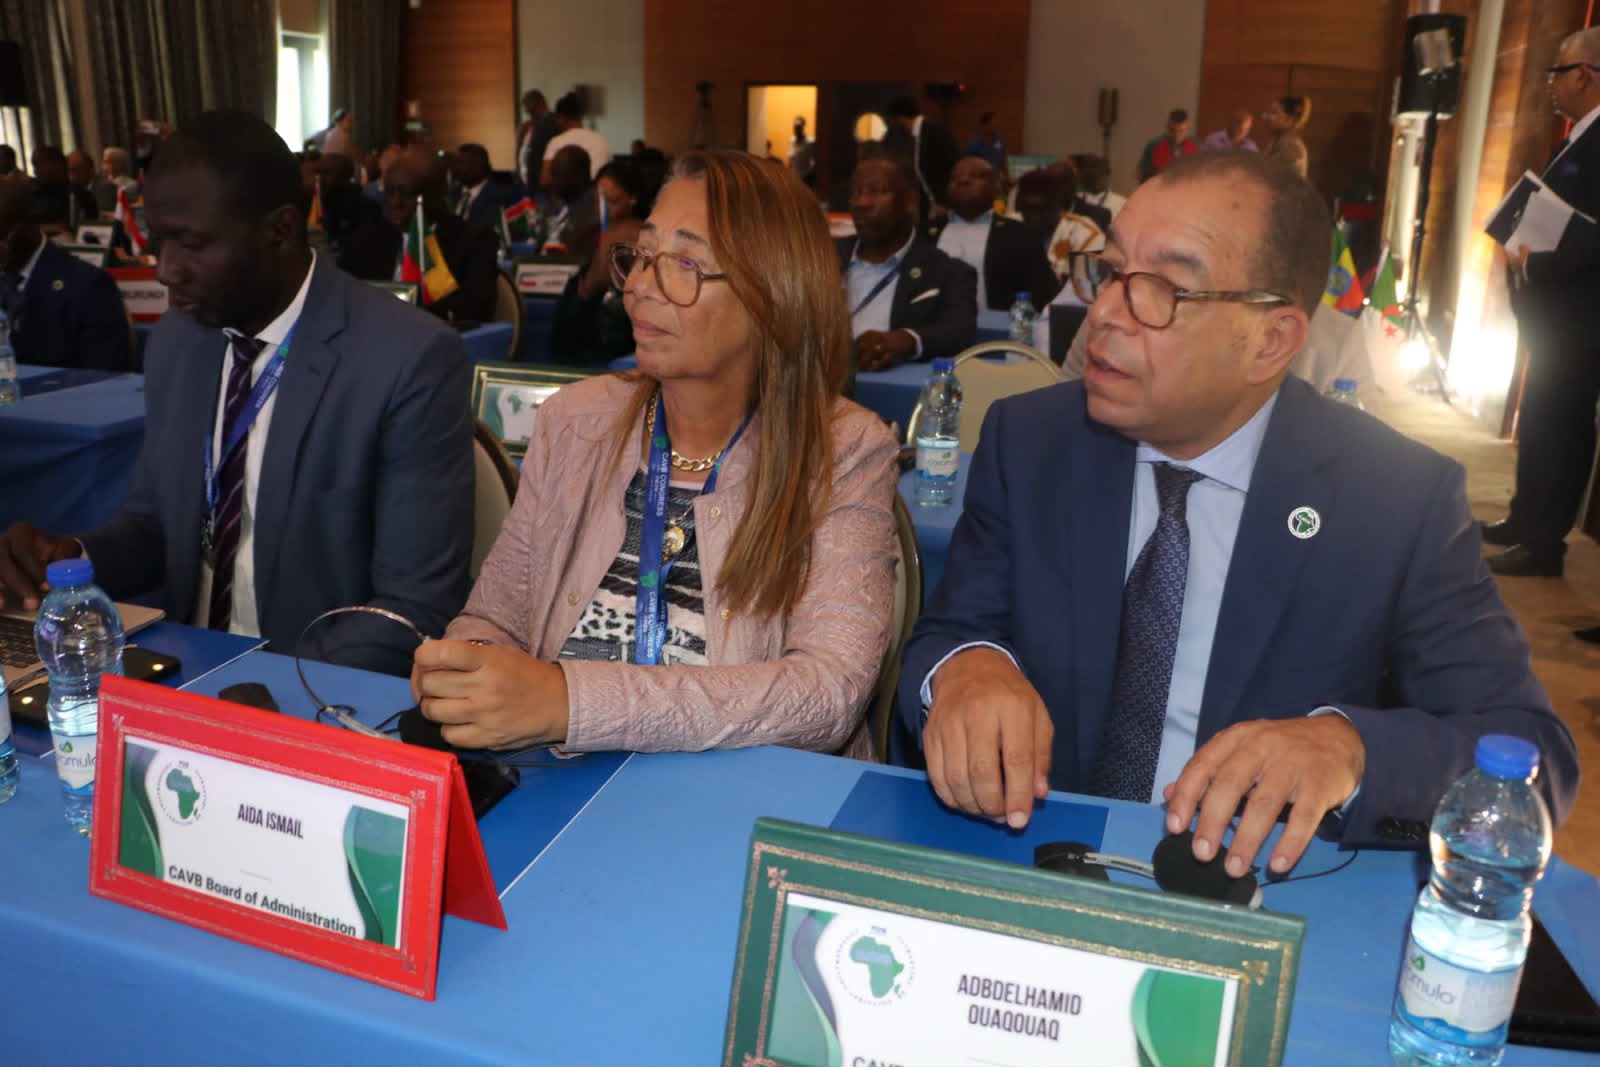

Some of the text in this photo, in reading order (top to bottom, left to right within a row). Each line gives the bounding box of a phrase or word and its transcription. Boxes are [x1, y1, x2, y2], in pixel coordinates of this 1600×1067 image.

[656, 474, 667, 517] CONGRESS
[237, 803, 304, 840] AIDA ISMAIL
[168, 865, 357, 938] CAVB Board of Administration
[957, 973, 1083, 1016] ADBDELHAMID
[968, 1003, 1061, 1043] OUAQOUAQ
